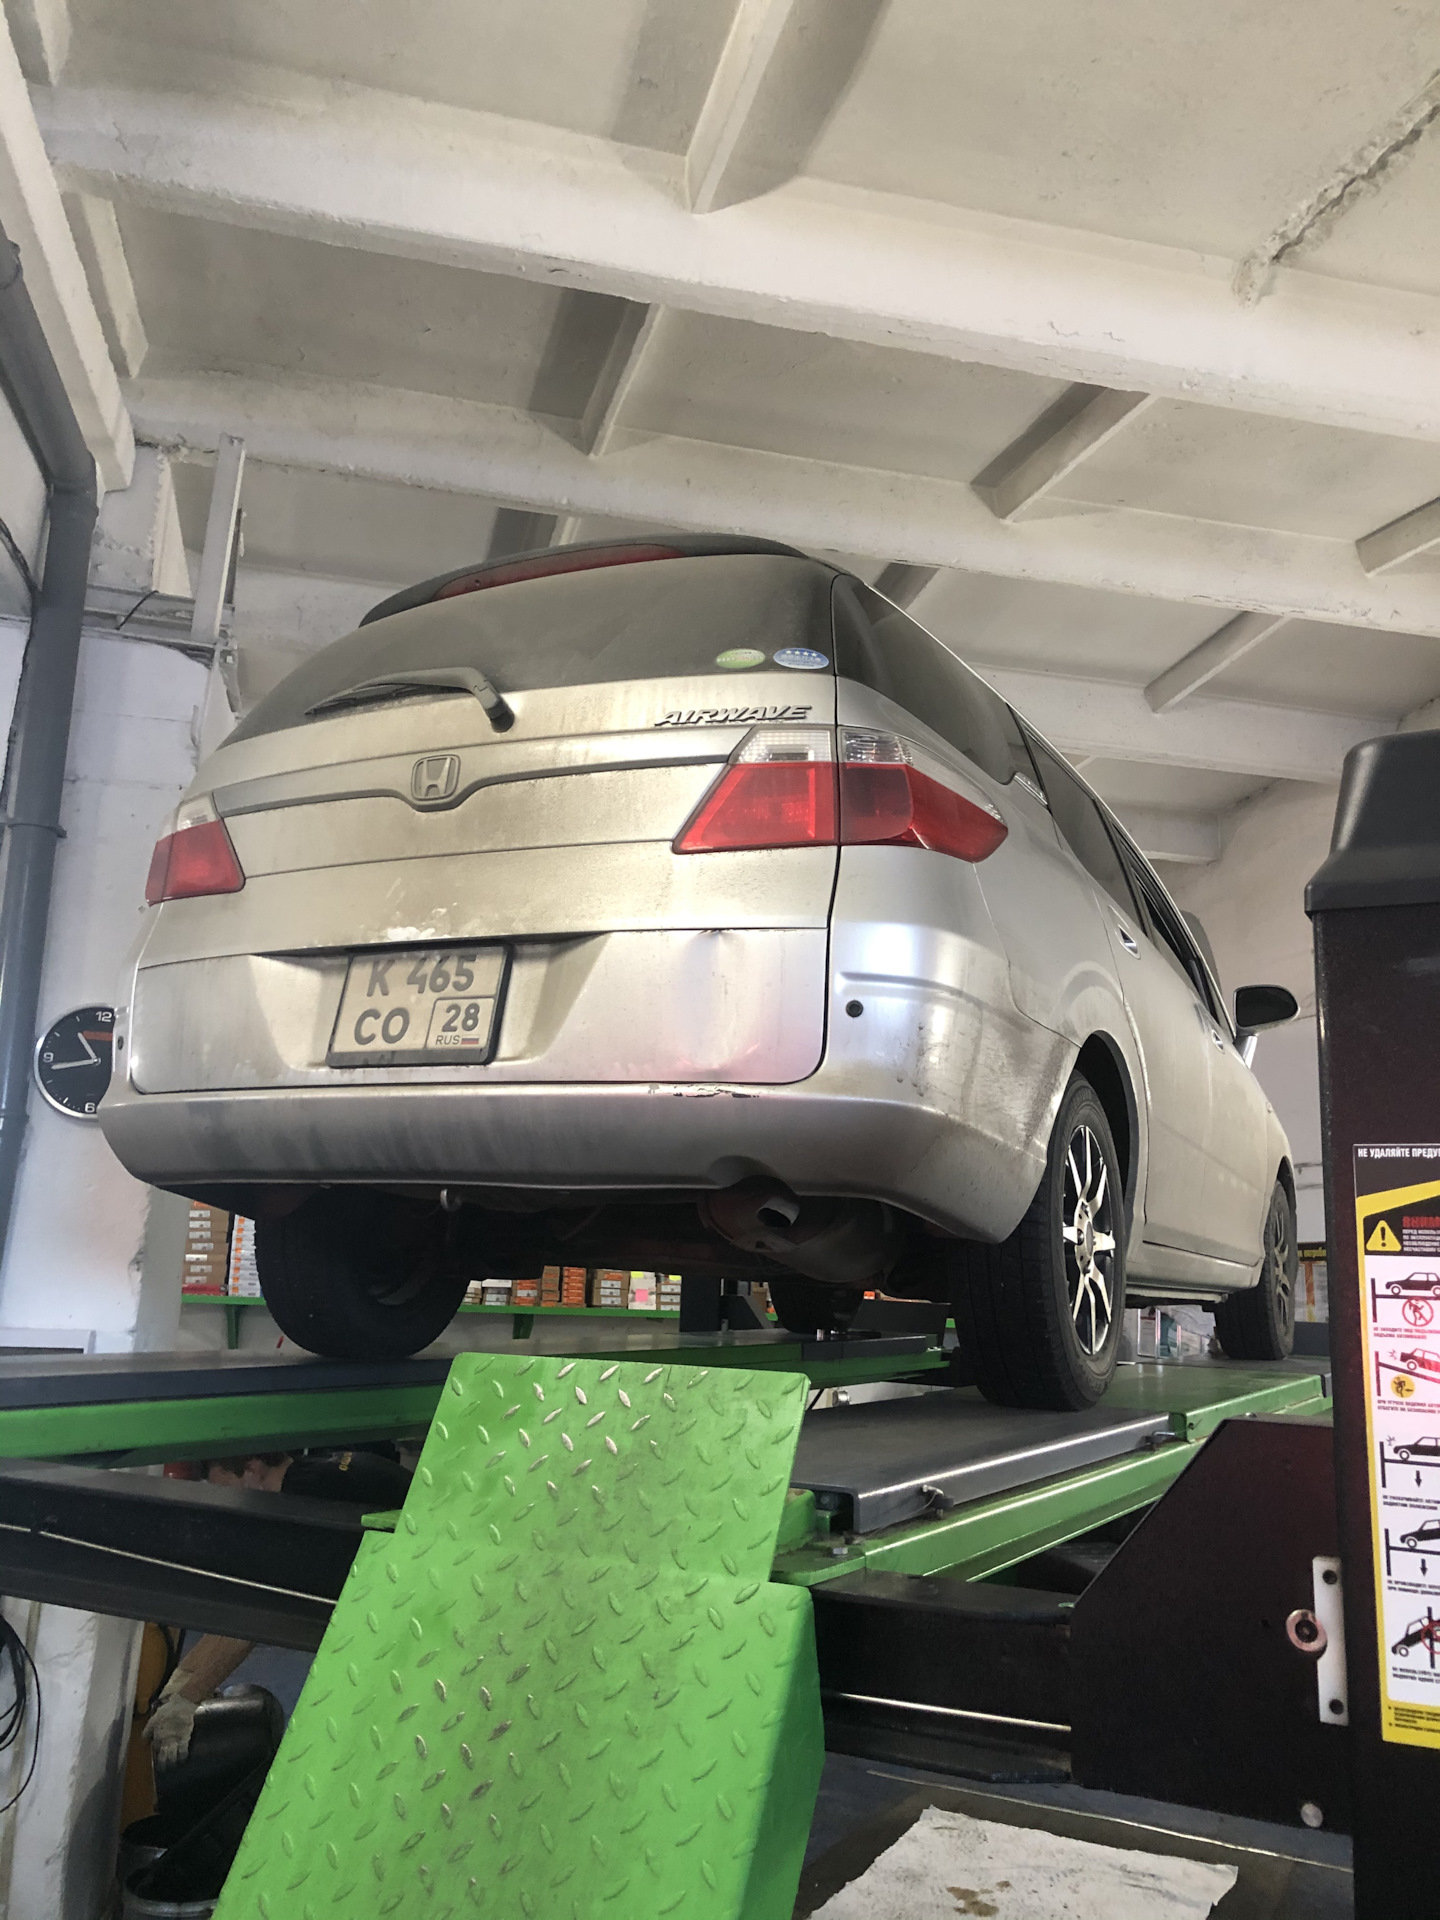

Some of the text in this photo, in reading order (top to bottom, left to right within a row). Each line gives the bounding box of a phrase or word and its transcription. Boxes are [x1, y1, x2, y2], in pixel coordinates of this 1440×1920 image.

[654, 705, 812, 727] AIRWAVE
[406, 955, 477, 993] 465
[95, 1011, 112, 1022] 12
[441, 1002, 480, 1033] 28
[435, 1034, 461, 1046] RUS
[43, 1052, 54, 1063] 9
[85, 1103, 96, 1113] 6
[1357, 1148, 1368, 1158] НЕ
[1369, 1146, 1410, 1159] УДАЛЯЙТЕ
